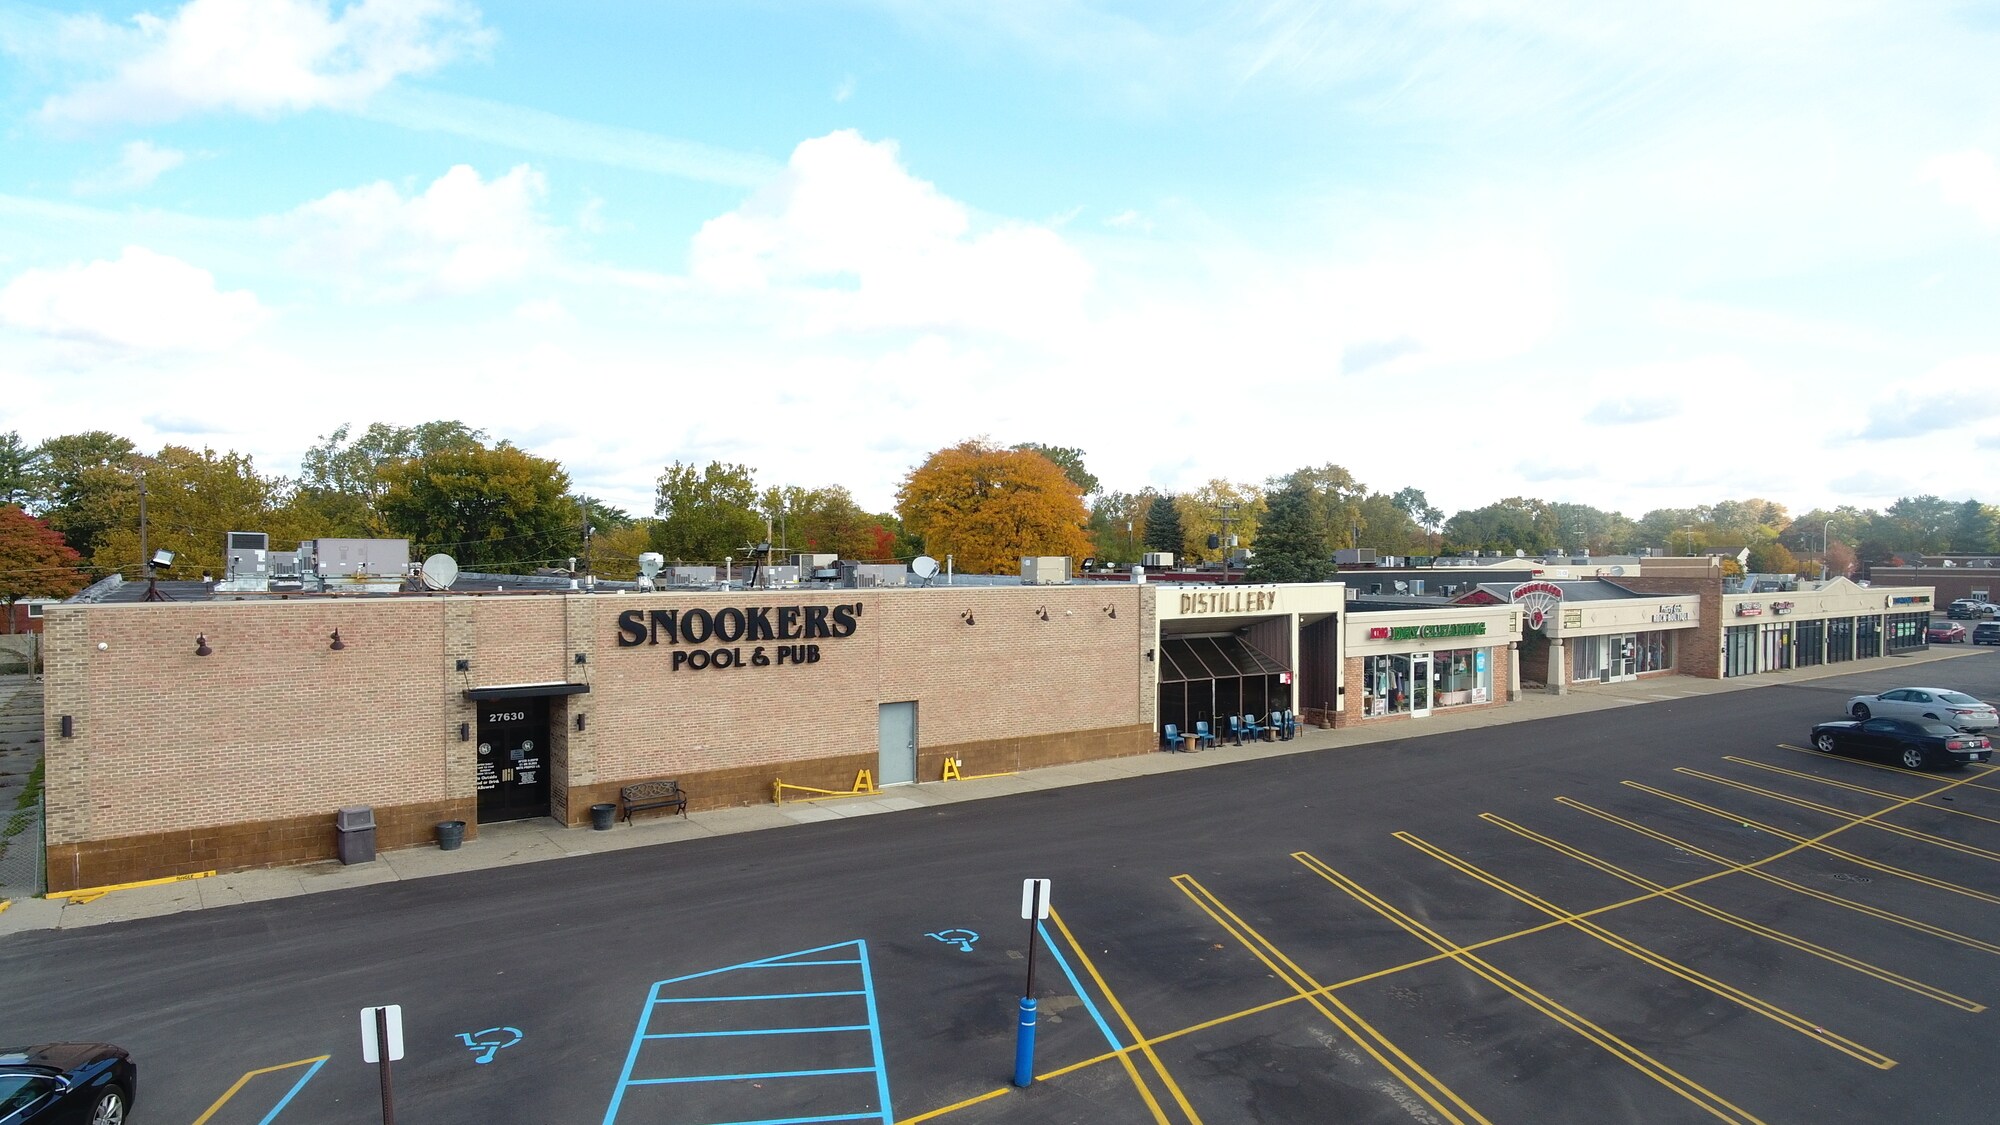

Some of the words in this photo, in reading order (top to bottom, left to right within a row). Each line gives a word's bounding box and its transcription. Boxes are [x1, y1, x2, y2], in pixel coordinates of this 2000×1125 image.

[1180, 590, 1276, 615] DISTILLERY
[618, 602, 863, 647] SNOOKERS'
[1391, 626, 1420, 640] DRY
[672, 648, 746, 671] POOL
[751, 646, 770, 666] &
[777, 644, 821, 665] PUB
[489, 711, 525, 722] 27630
